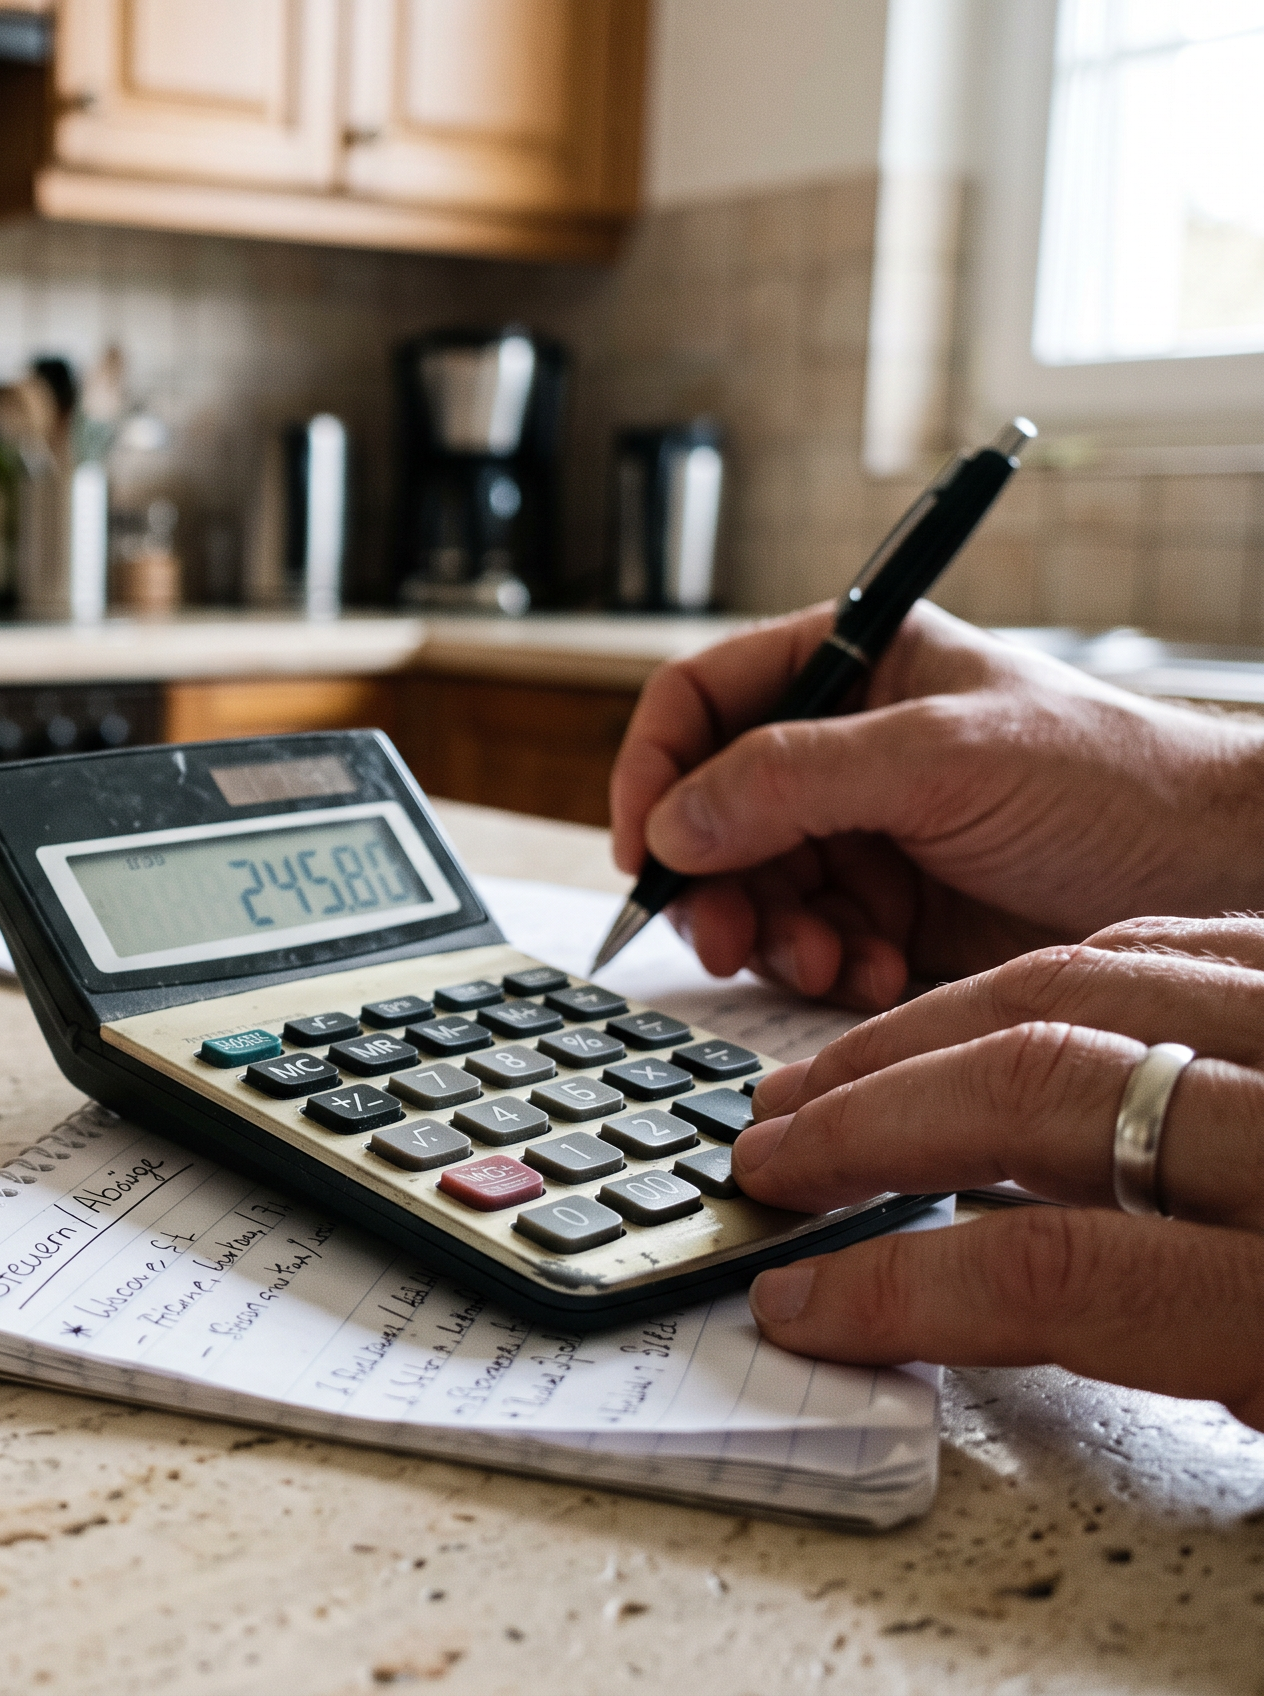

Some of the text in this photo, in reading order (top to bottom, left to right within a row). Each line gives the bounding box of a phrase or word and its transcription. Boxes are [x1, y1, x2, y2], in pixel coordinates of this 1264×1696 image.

[347, 1039, 403, 1059] MR
[267, 1058, 325, 1079] MC
[494, 1052, 527, 1069] 8
[415, 1070, 447, 1089] 7
[490, 1104, 521, 1123] 4
[631, 1118, 671, 1137] 2
[559, 1142, 592, 1161] 1
[625, 1175, 680, 1201] 00
[551, 1206, 590, 1227] 0
